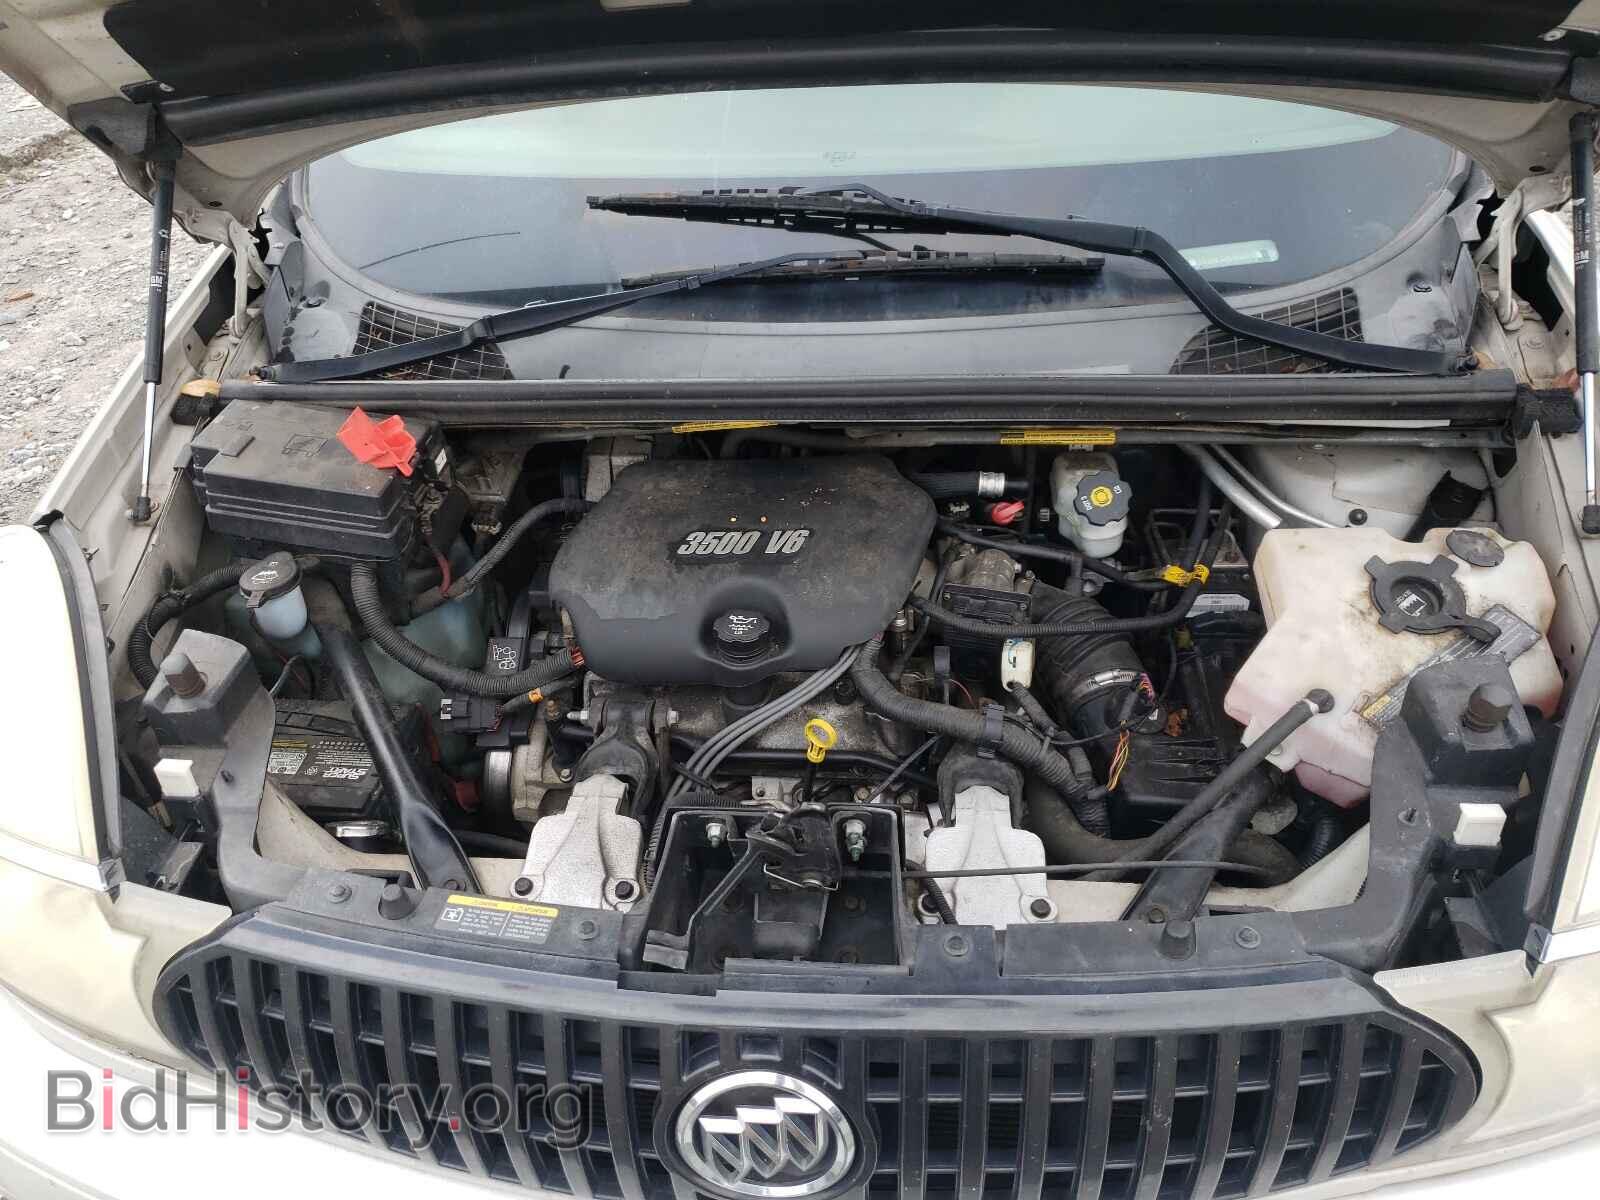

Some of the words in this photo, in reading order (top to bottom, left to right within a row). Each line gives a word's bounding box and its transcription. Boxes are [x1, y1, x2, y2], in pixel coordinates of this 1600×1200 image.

[677, 530, 761, 555] 3500
[764, 529, 810, 554] V6
[322, 770, 360, 780] SUPER
